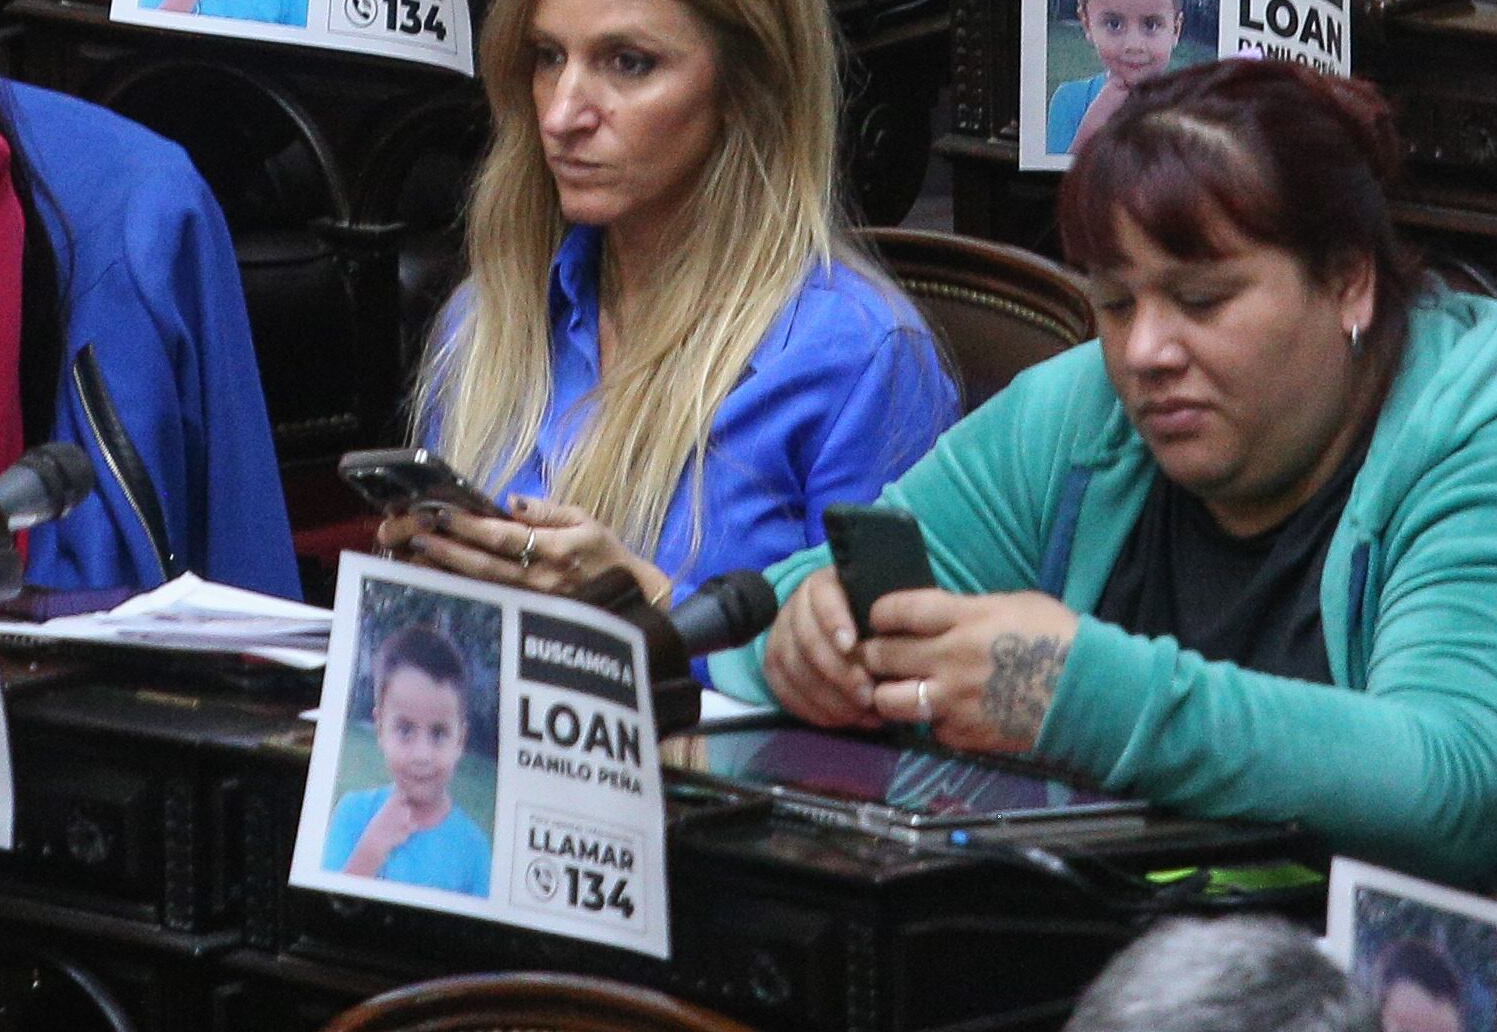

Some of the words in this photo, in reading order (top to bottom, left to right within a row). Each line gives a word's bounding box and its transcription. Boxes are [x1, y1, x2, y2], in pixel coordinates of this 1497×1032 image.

[524, 634, 621, 681] BUSCAMOS
[621, 663, 634, 687] A
[519, 696, 641, 768] LOAN
[517, 749, 592, 781] DANILO
[598, 767, 643, 795] PEÑA
[529, 827, 634, 873] LLAMAR
[564, 865, 635, 920] 134
